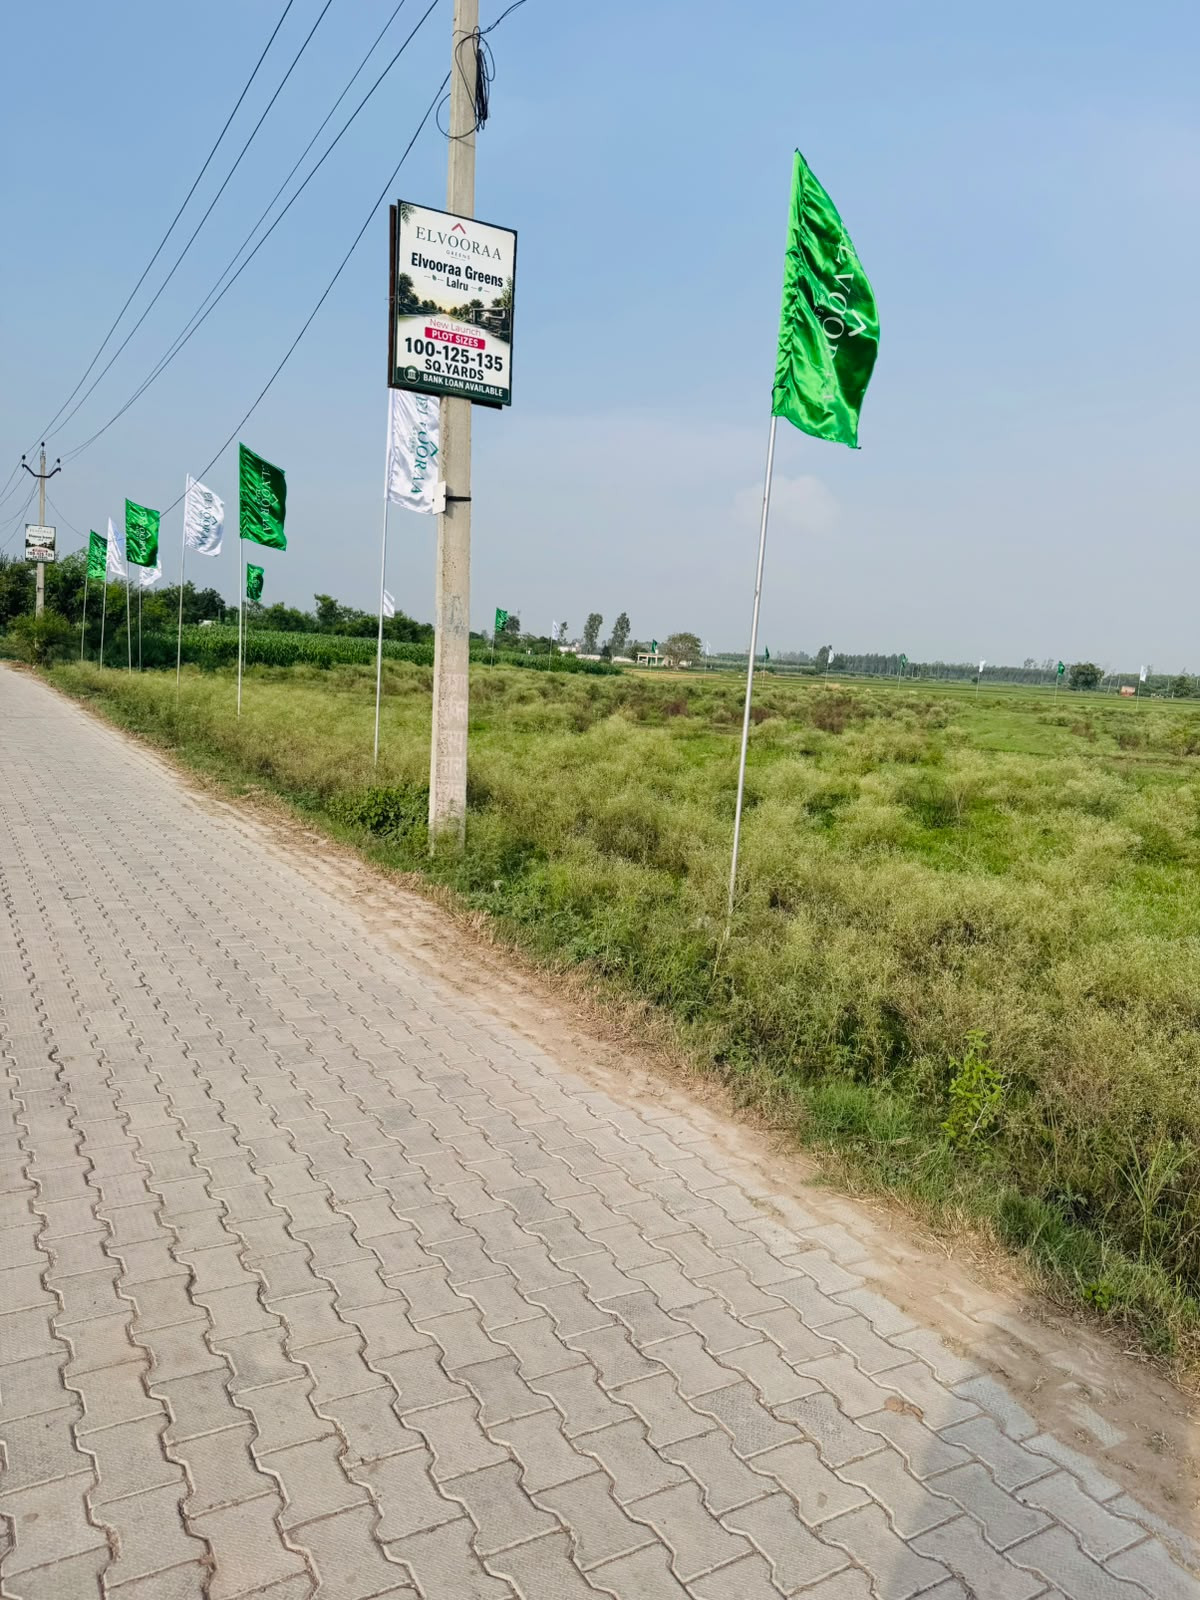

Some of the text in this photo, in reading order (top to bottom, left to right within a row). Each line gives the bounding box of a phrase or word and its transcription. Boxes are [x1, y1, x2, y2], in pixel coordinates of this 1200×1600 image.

[415, 226, 502, 261] ELVOORAA
[411, 252, 504, 288] Elvooraa Greens
[446, 277, 469, 291] Lalru
[429, 318, 481, 337] New Launch
[431, 329, 479, 348] PLOT SIZES
[405, 337, 503, 372] 100-125-135
[424, 358, 484, 381] SQ.YARDS
[423, 373, 503, 397] BANK LOAN AVAILABLE
